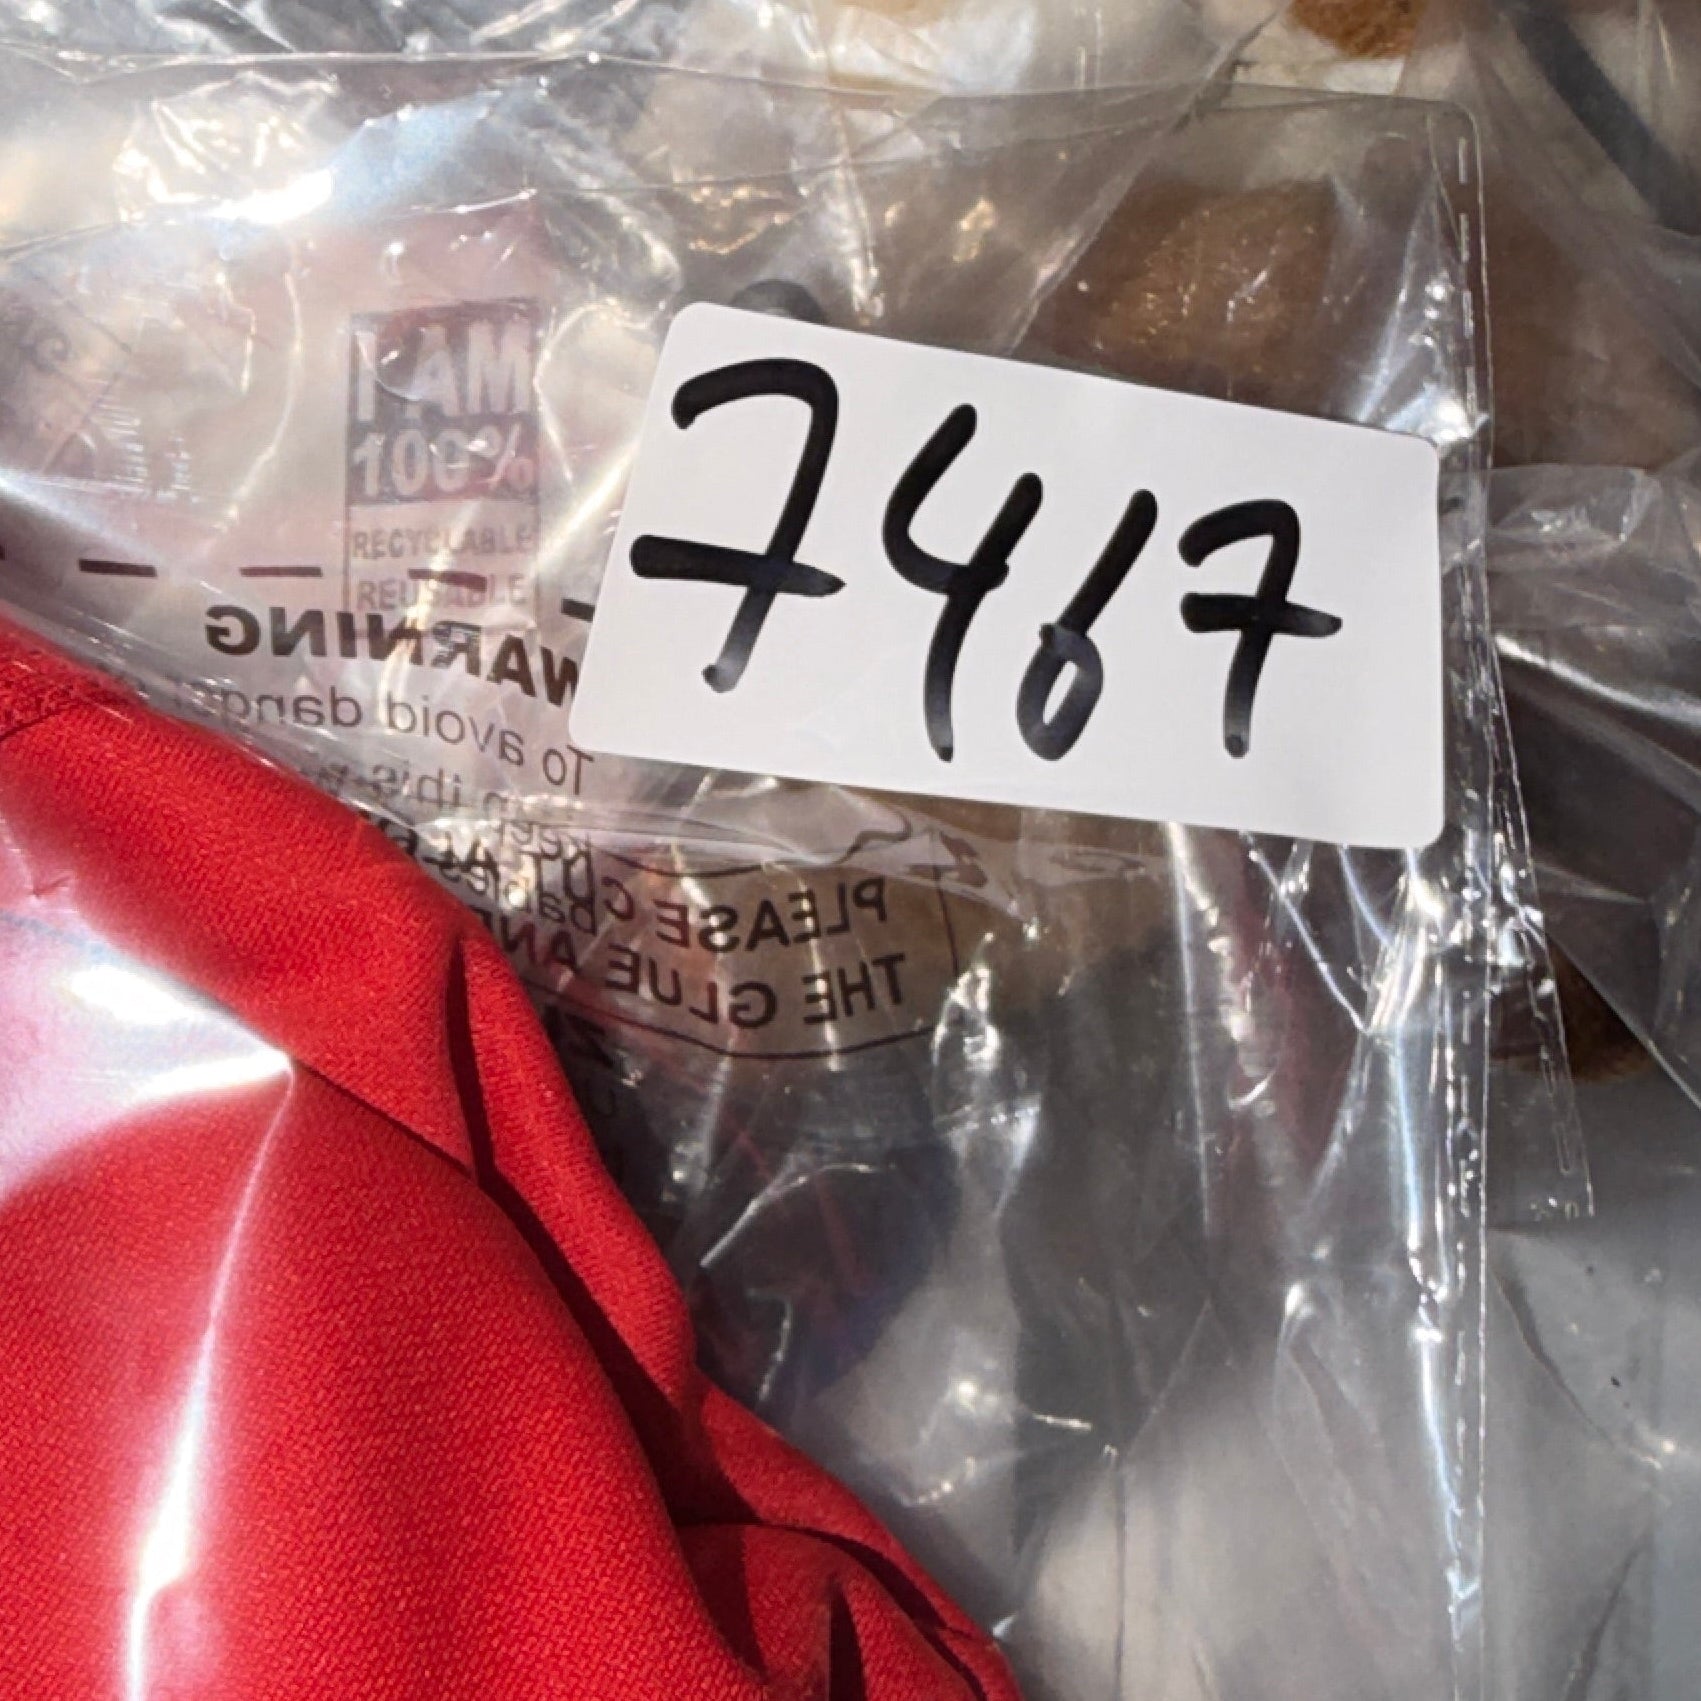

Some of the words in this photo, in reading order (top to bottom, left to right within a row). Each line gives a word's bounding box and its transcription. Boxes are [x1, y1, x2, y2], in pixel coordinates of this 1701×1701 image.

[402, 318, 534, 420] AM
[353, 423, 536, 498] 100%
[629, 356, 1343, 763] 7467
